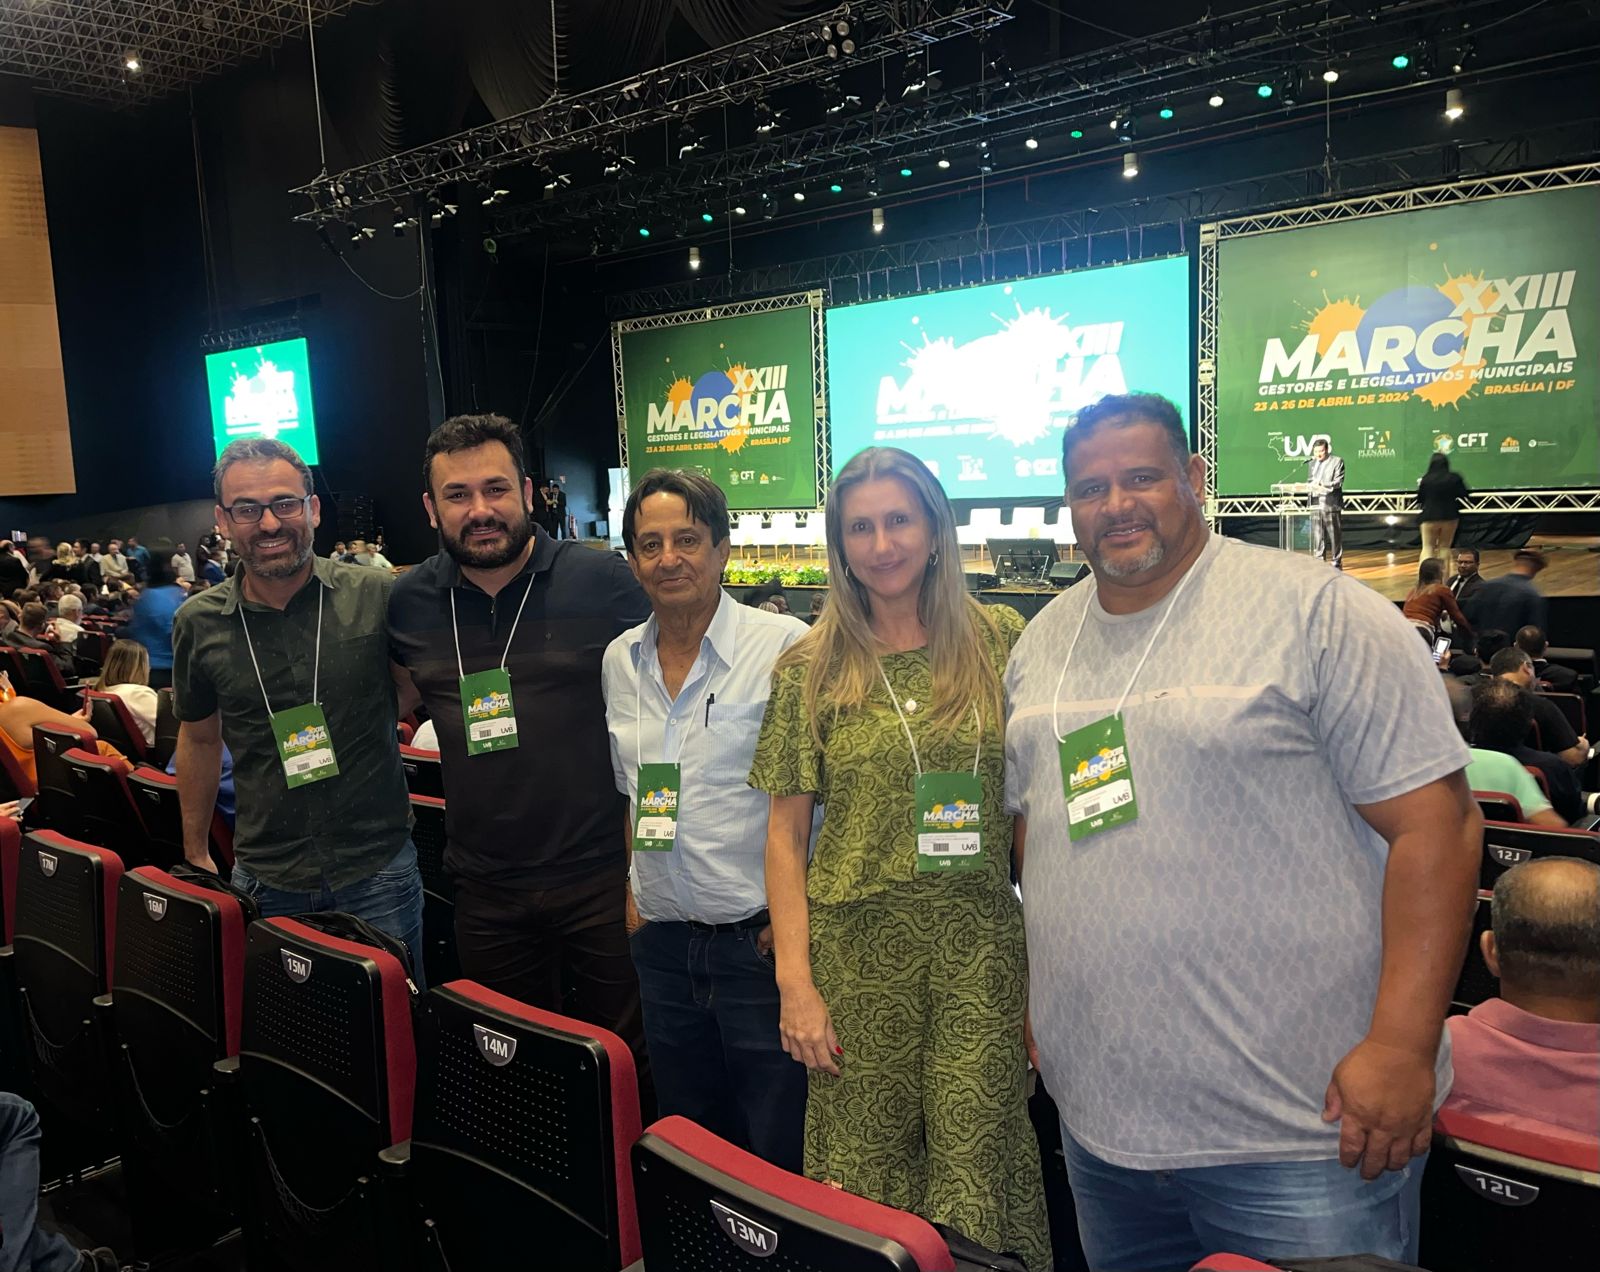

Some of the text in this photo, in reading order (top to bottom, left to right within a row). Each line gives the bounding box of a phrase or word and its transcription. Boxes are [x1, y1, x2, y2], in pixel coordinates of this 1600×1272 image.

[1450, 270, 1577, 318] XXIII
[1258, 308, 1578, 384] MARCHA
[732, 364, 788, 393] XXIII
[1258, 361, 1574, 396] GESTORES E LEGISLATIVOS MUNICIPAIS
[1484, 380, 1545, 395] BRASÍLIA
[1555, 379, 1576, 391] DF
[646, 389, 792, 434] MARCHA
[1253, 392, 1410, 412] 23 A 26 DE ABRIL DE 2024
[647, 424, 790, 443] GESTORES E LEGISLATIVOS MUNICIPAIS
[1457, 432, 1489, 448] CFT
[740, 470, 755, 480] CFT
[467, 699, 511, 714] MARCHA
[283, 731, 327, 751] MARCHA
[1069, 753, 1128, 785] MARCHA
[640, 797, 678, 806] MARCHA
[923, 810, 980, 821] MARCHA
[42, 857, 54, 871] 17M
[1496, 849, 1521, 862] 12J
[148, 899, 163, 915] 16M
[287, 958, 306, 977] 15M
[482, 1035, 508, 1058] 14M
[1476, 1177, 1519, 1200] 12L
[726, 1217, 767, 1250] 13M
